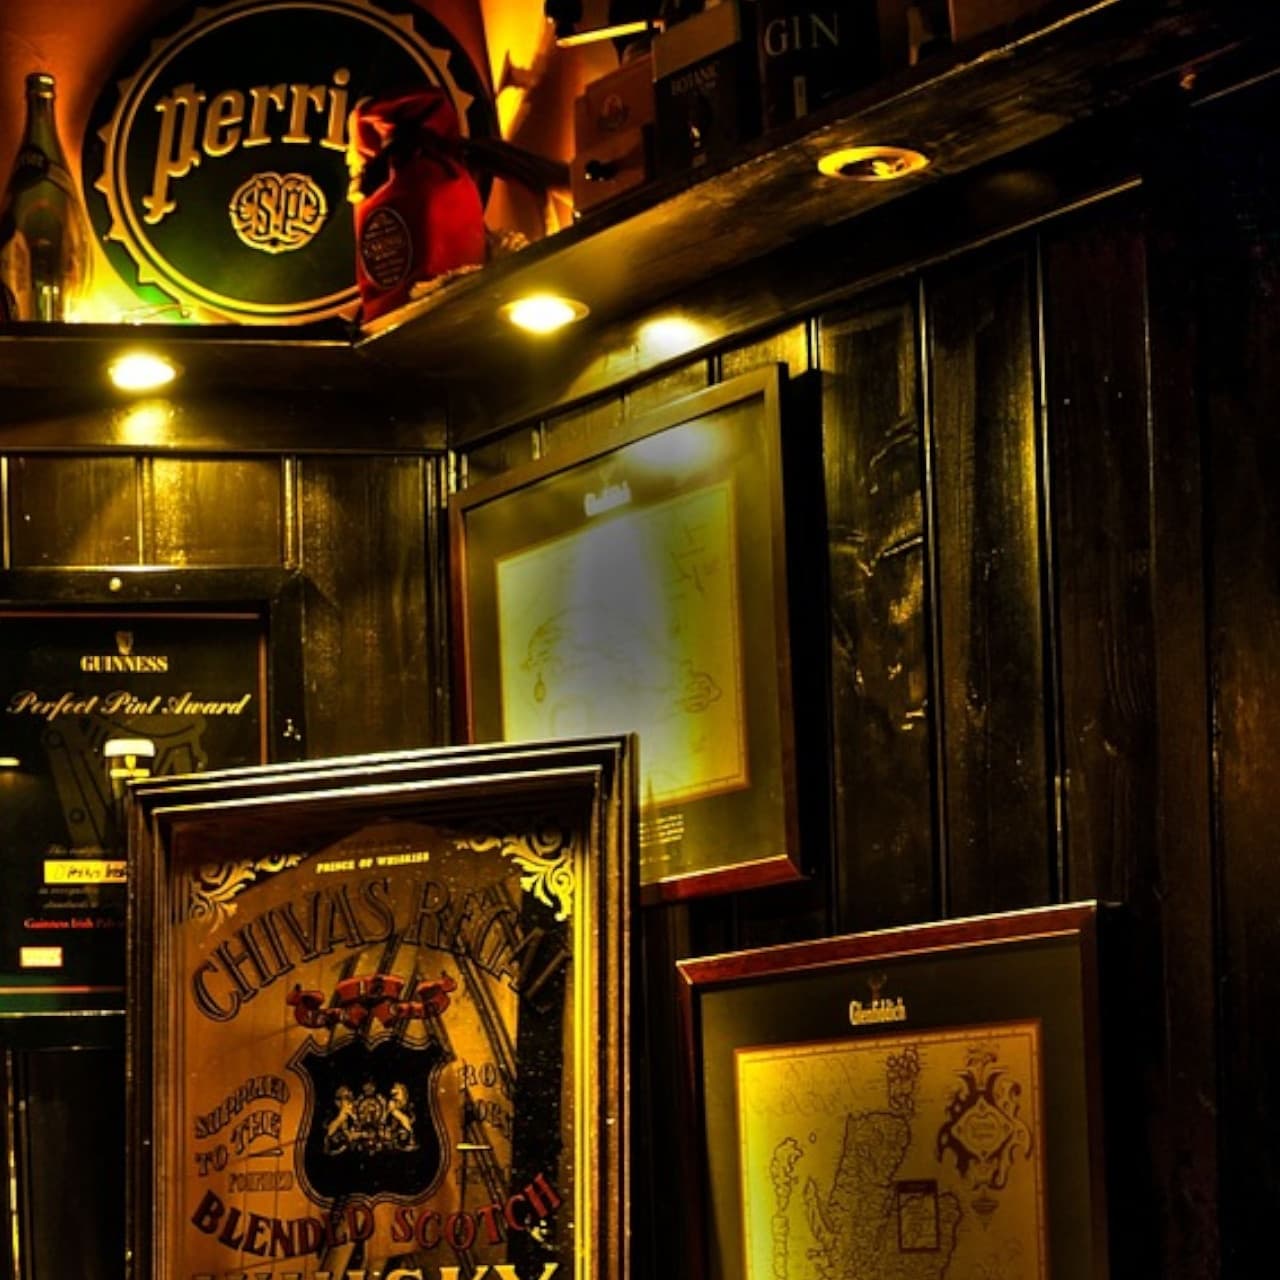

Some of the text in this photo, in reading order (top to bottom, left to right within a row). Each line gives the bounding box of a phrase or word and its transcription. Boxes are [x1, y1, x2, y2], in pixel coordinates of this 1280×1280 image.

[763, 9, 841, 58] GIN
[80, 655, 169, 673] GUINNESS
[6, 691, 251, 721] Perfect Pint Award
[191, 877, 399, 1023] CHIVAS
[191, 1172, 563, 1259] BLENDED SCOTCH
